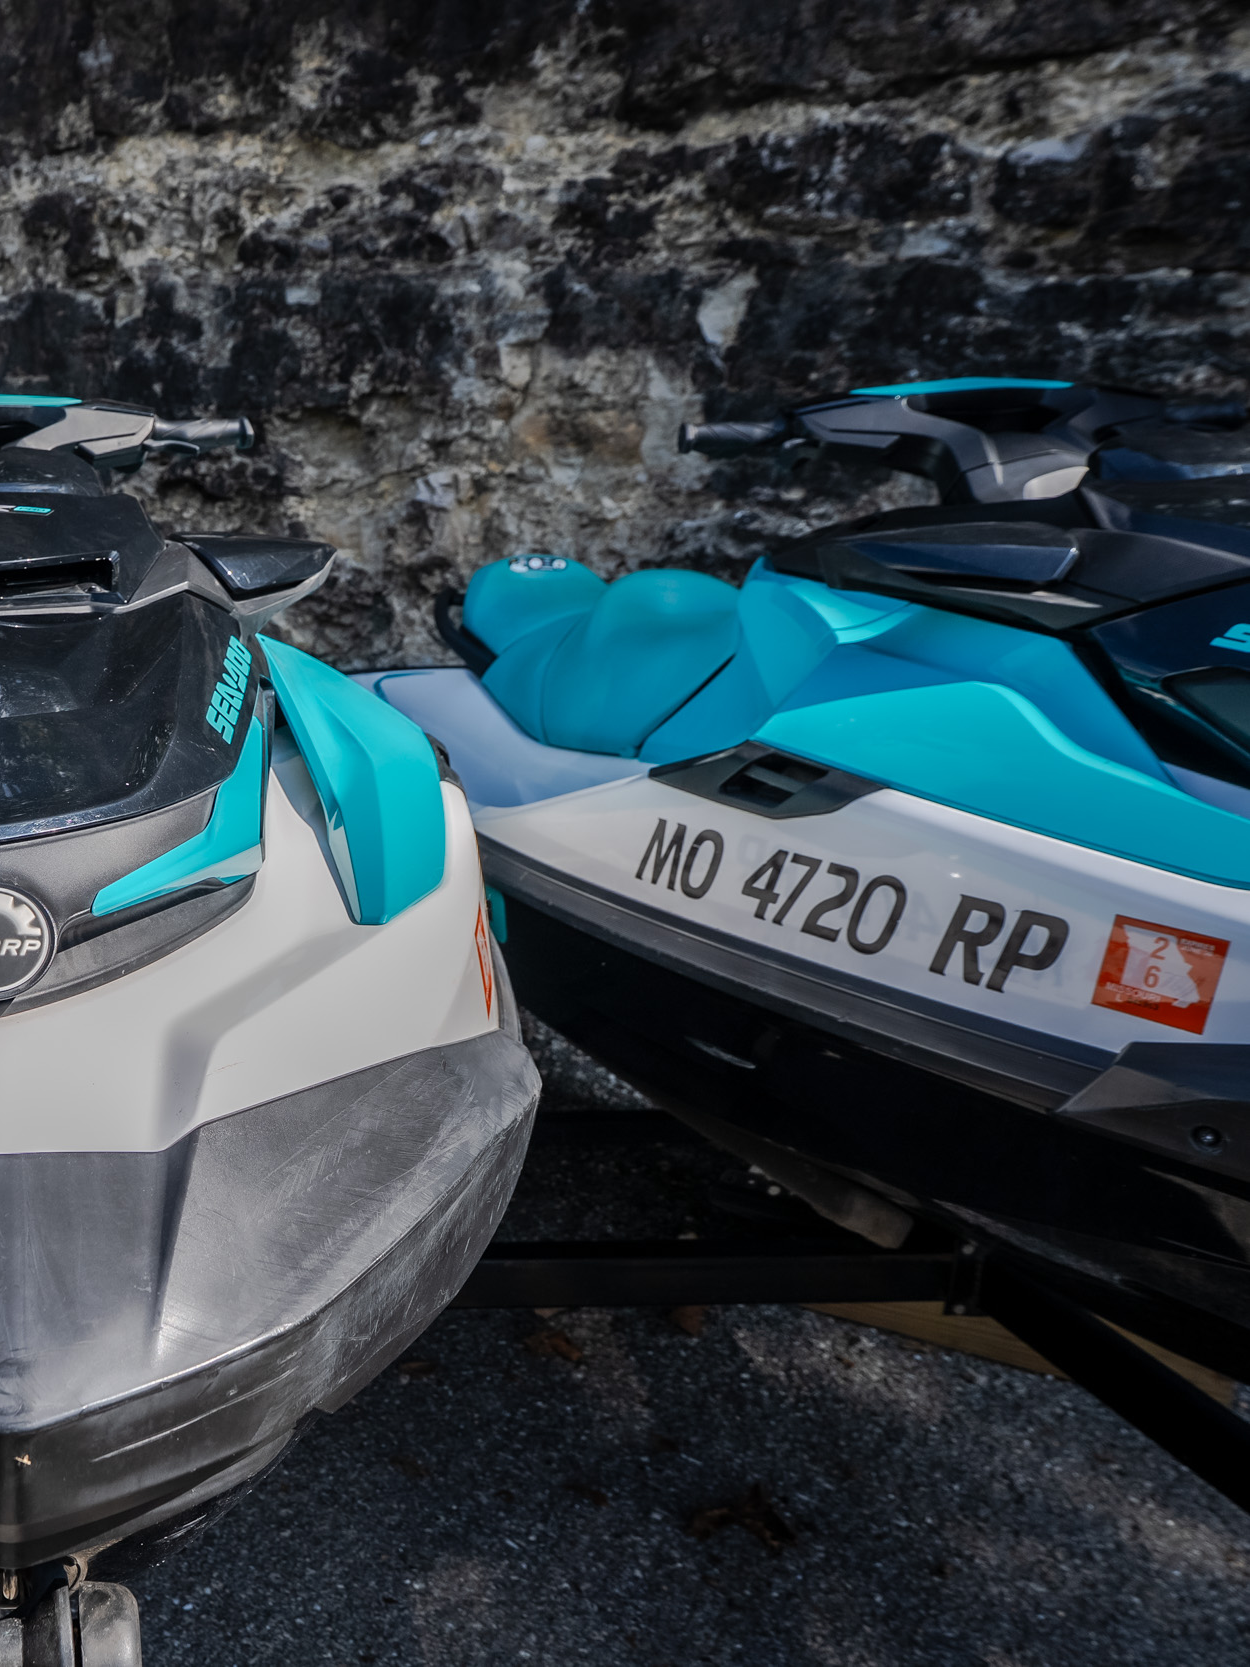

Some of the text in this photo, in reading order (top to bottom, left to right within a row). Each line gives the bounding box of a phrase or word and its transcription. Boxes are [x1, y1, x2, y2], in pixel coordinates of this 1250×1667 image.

[635, 817, 1071, 994] MO 4720 RP
[1151, 936, 1170, 960] 2
[1143, 965, 1161, 988] 6
